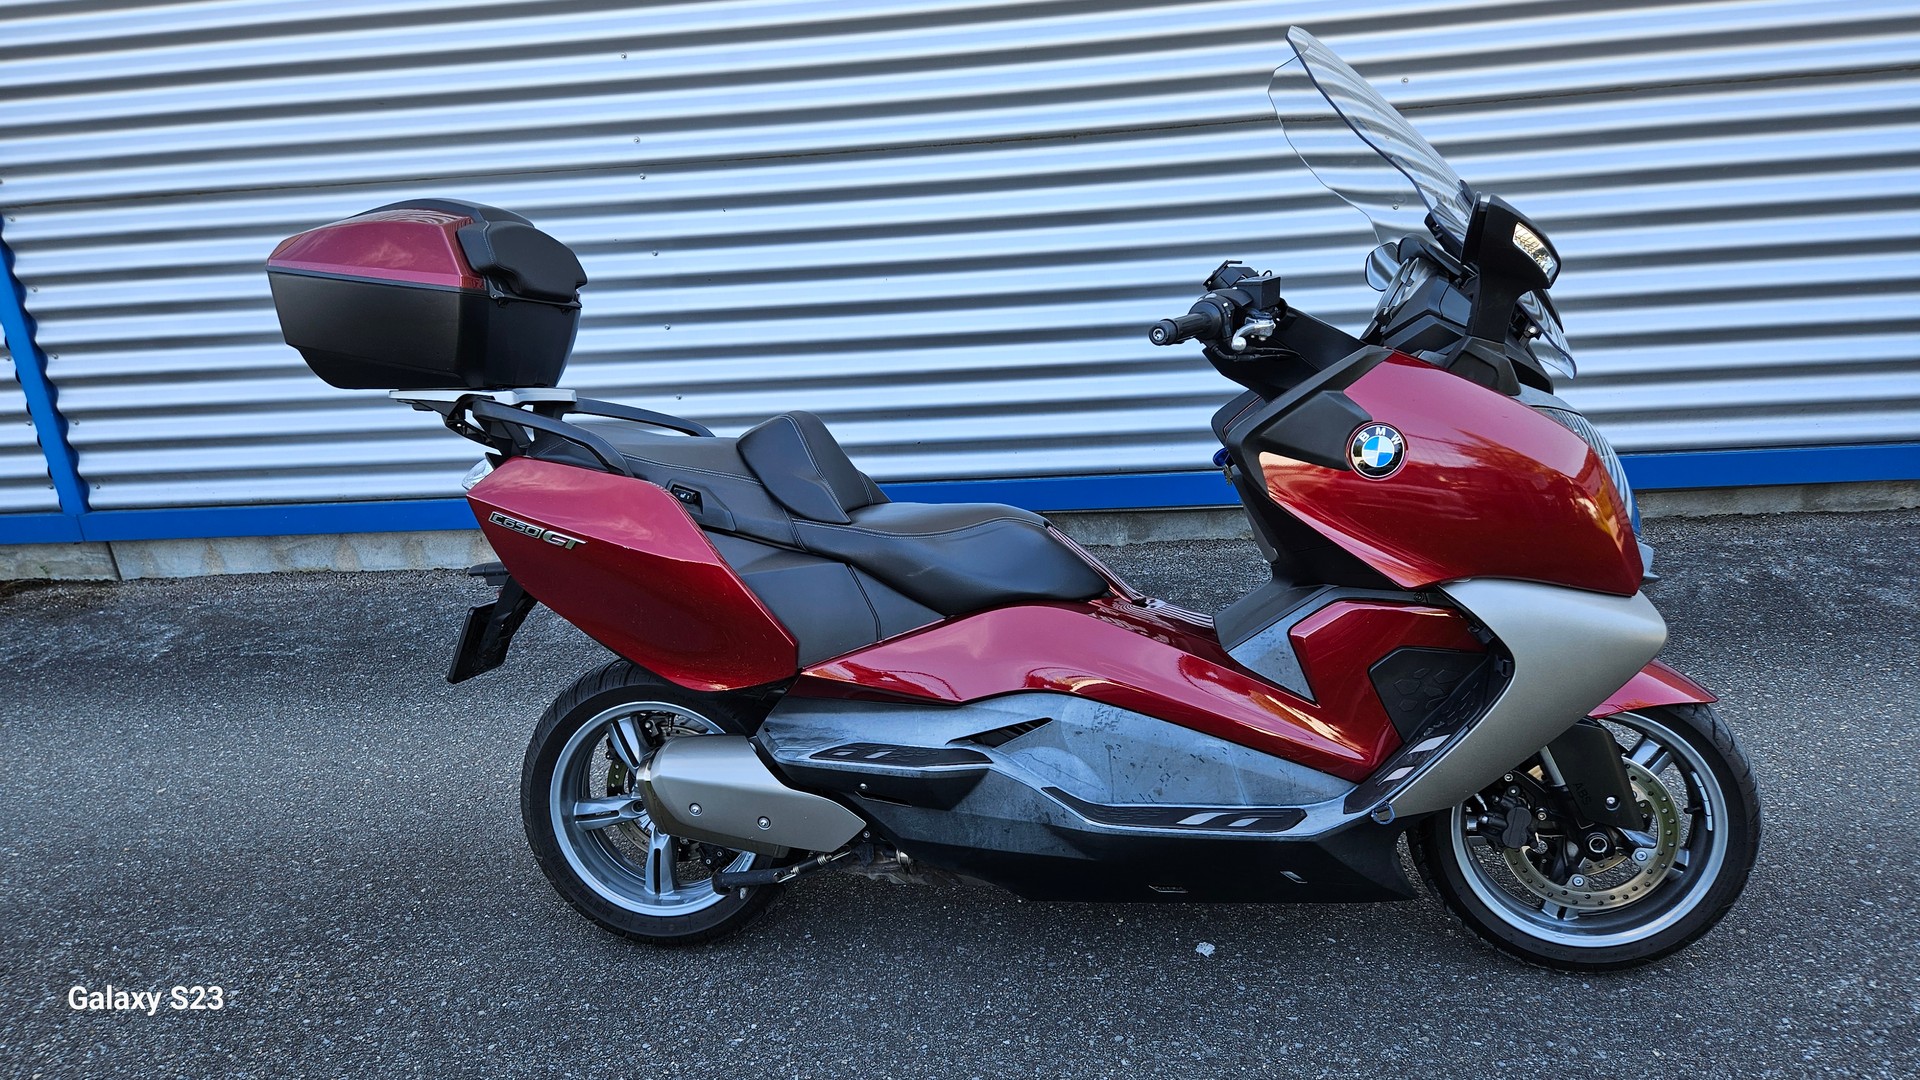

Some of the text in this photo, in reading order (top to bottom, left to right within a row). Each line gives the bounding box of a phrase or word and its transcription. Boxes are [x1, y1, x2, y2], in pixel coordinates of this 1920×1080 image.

[1358, 427, 1402, 445] BMW
[490, 512, 588, 550] C650 GT
